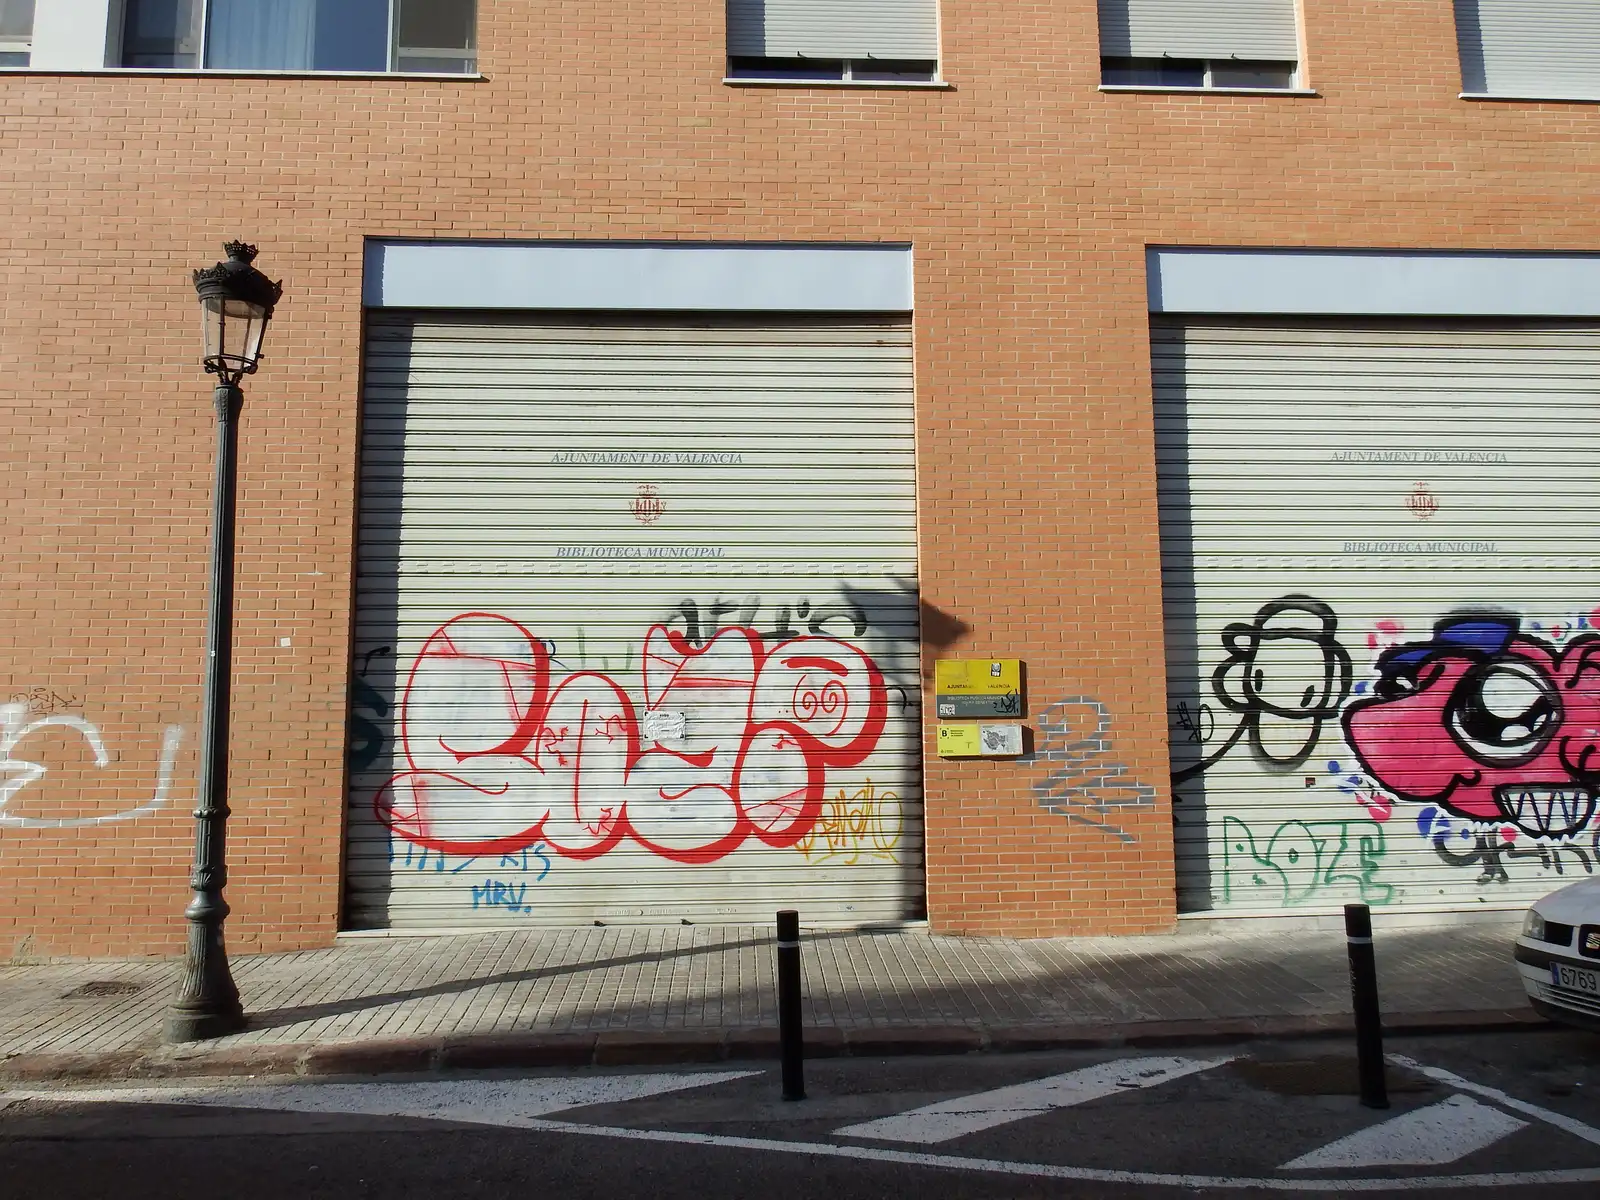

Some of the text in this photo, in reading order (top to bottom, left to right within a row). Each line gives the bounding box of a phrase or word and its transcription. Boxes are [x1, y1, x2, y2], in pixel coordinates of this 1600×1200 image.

[551, 453, 743, 465] AJUNTAMENT DE VALENCIA
[1331, 451, 1508, 463] AJUNTAMENT DE VALENCIA
[556, 547, 726, 558] BIBLIOTECA MUNICIPAL
[1344, 542, 1499, 553] BIBLIOTECA MUNICIPAL
[1561, 967, 1597, 991] 6769
